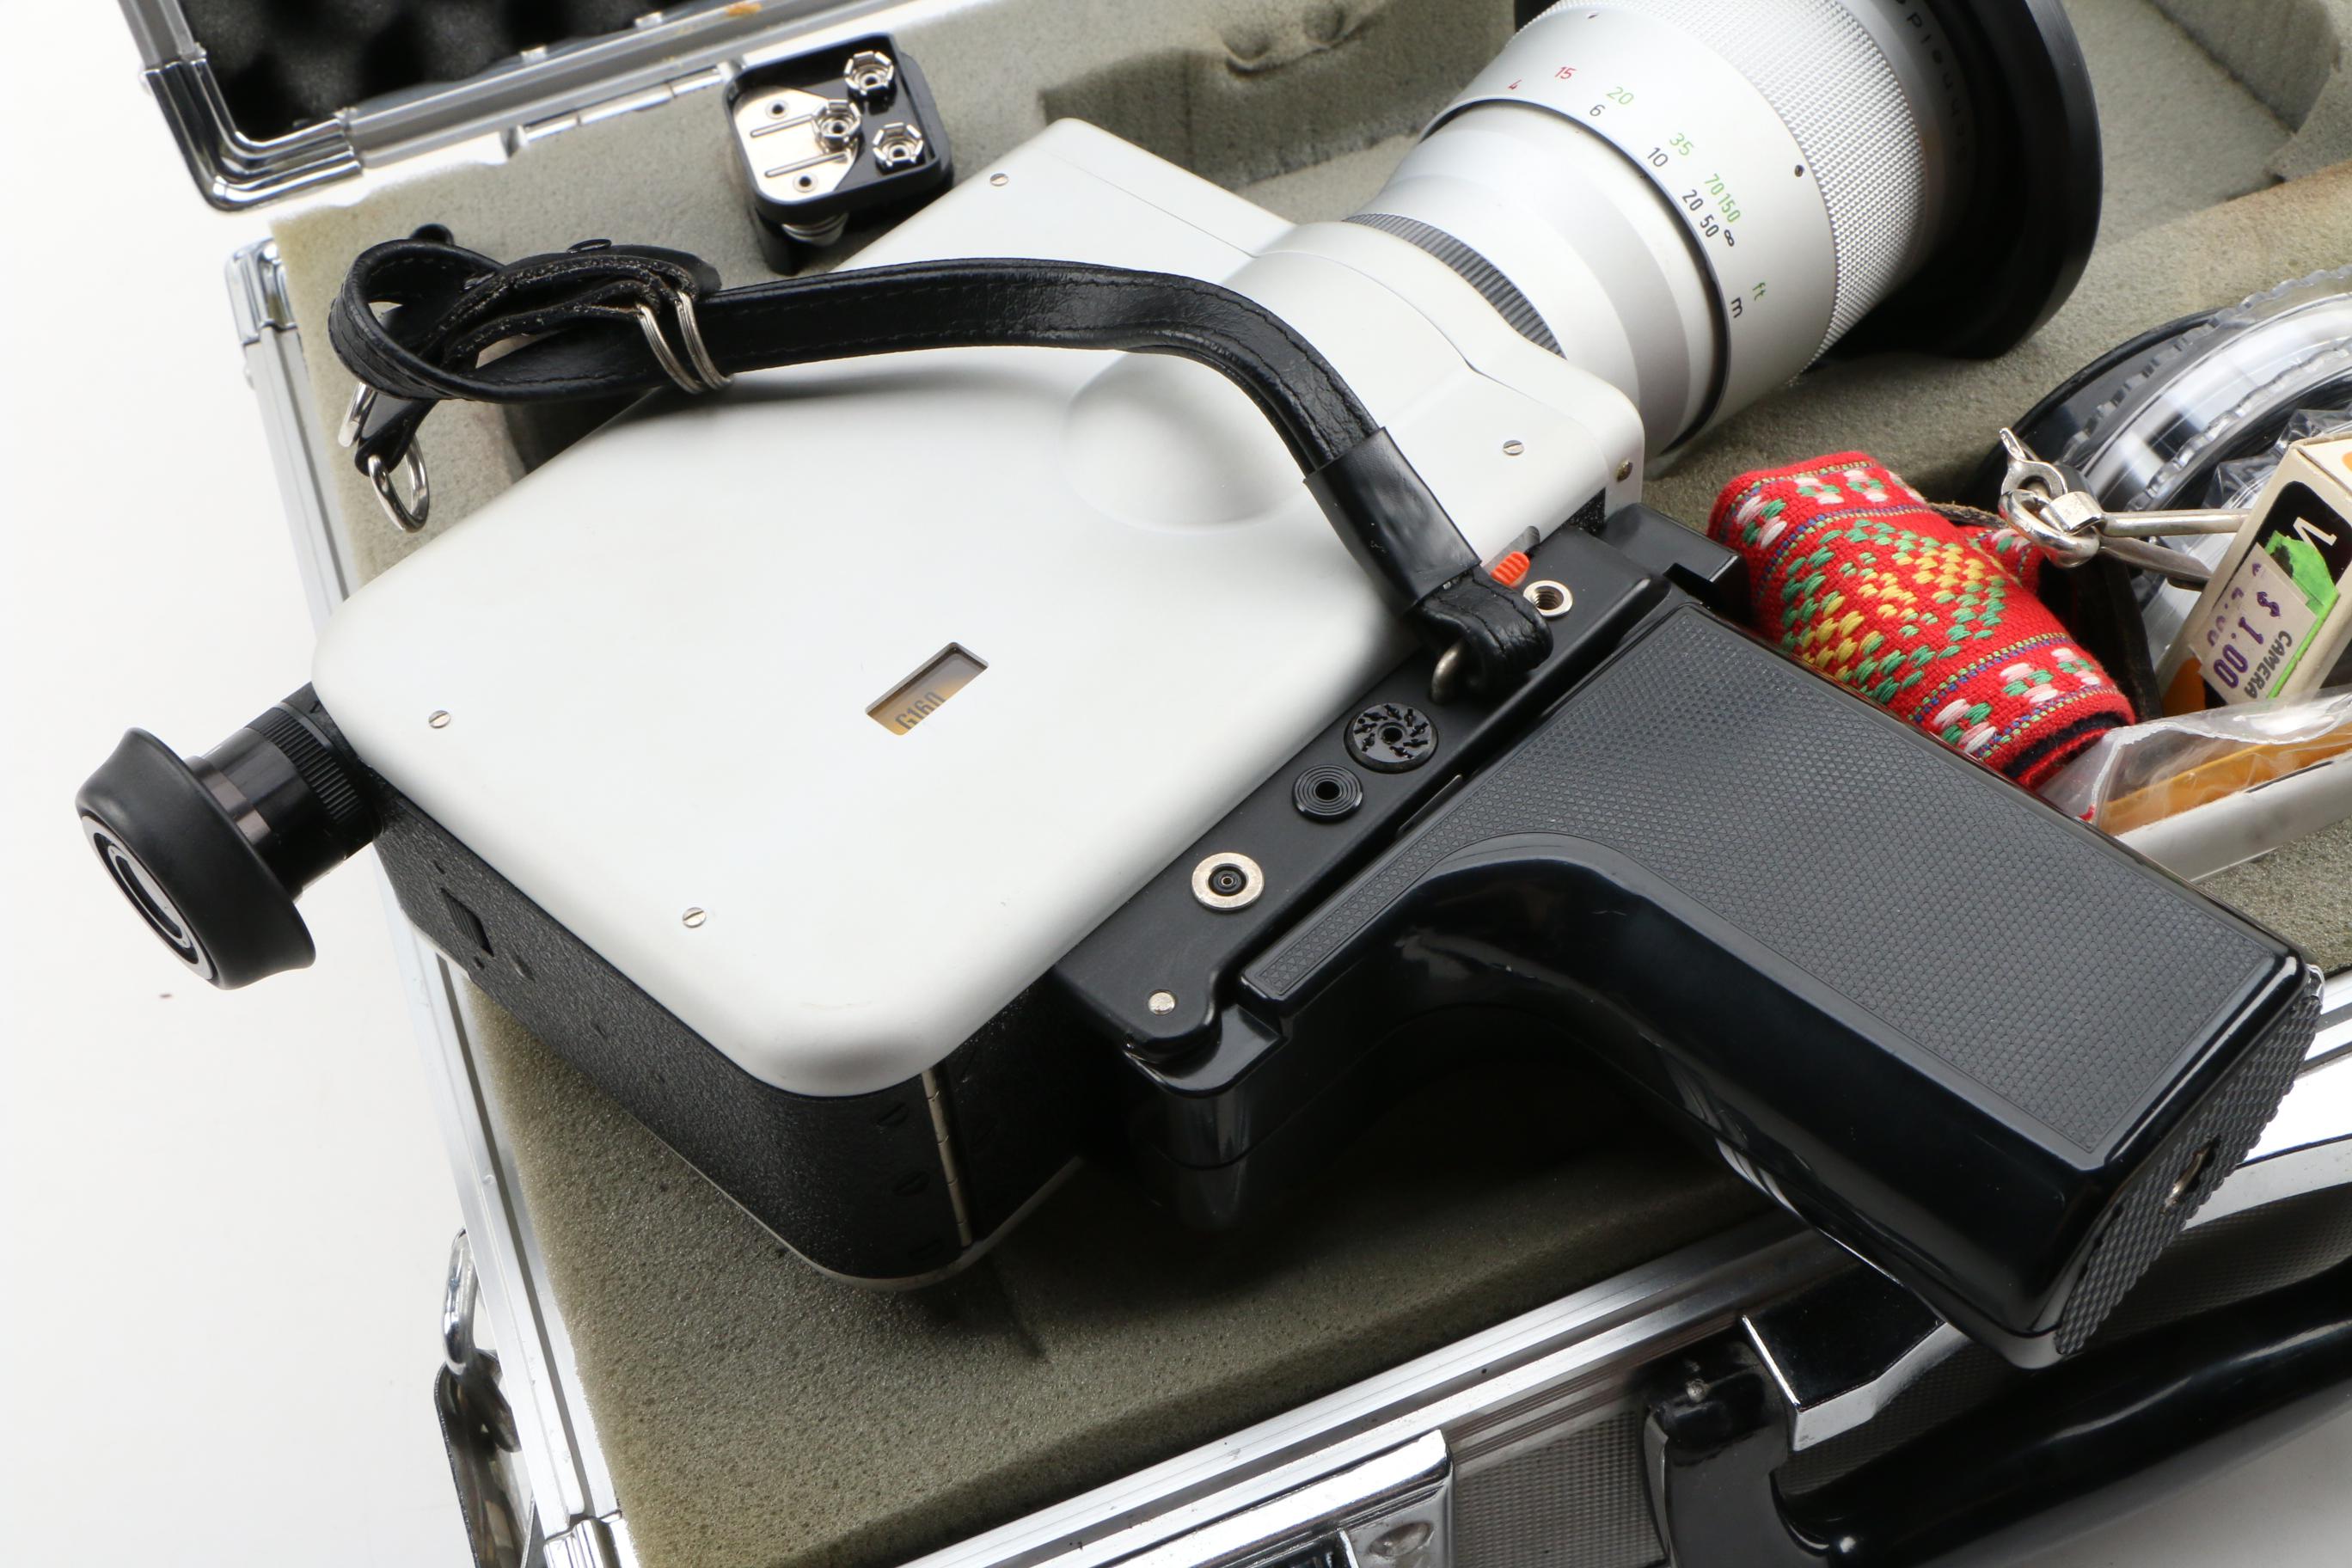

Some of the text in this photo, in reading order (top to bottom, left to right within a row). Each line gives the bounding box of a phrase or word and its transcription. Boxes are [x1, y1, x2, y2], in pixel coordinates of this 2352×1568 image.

[1507, 79, 1522, 90] 4
[1589, 104, 1606, 117] 6
[1647, 147, 1669, 168] 10
[1681, 189, 1704, 211] 20
[1700, 214, 1719, 237] 50
[1730, 297, 1743, 319] m
[1554, 66, 1766, 301] 15 20 35 70 150 ft
[2214, 616, 2263, 689] 1.00
[2244, 630, 2293, 698] CAMERA
